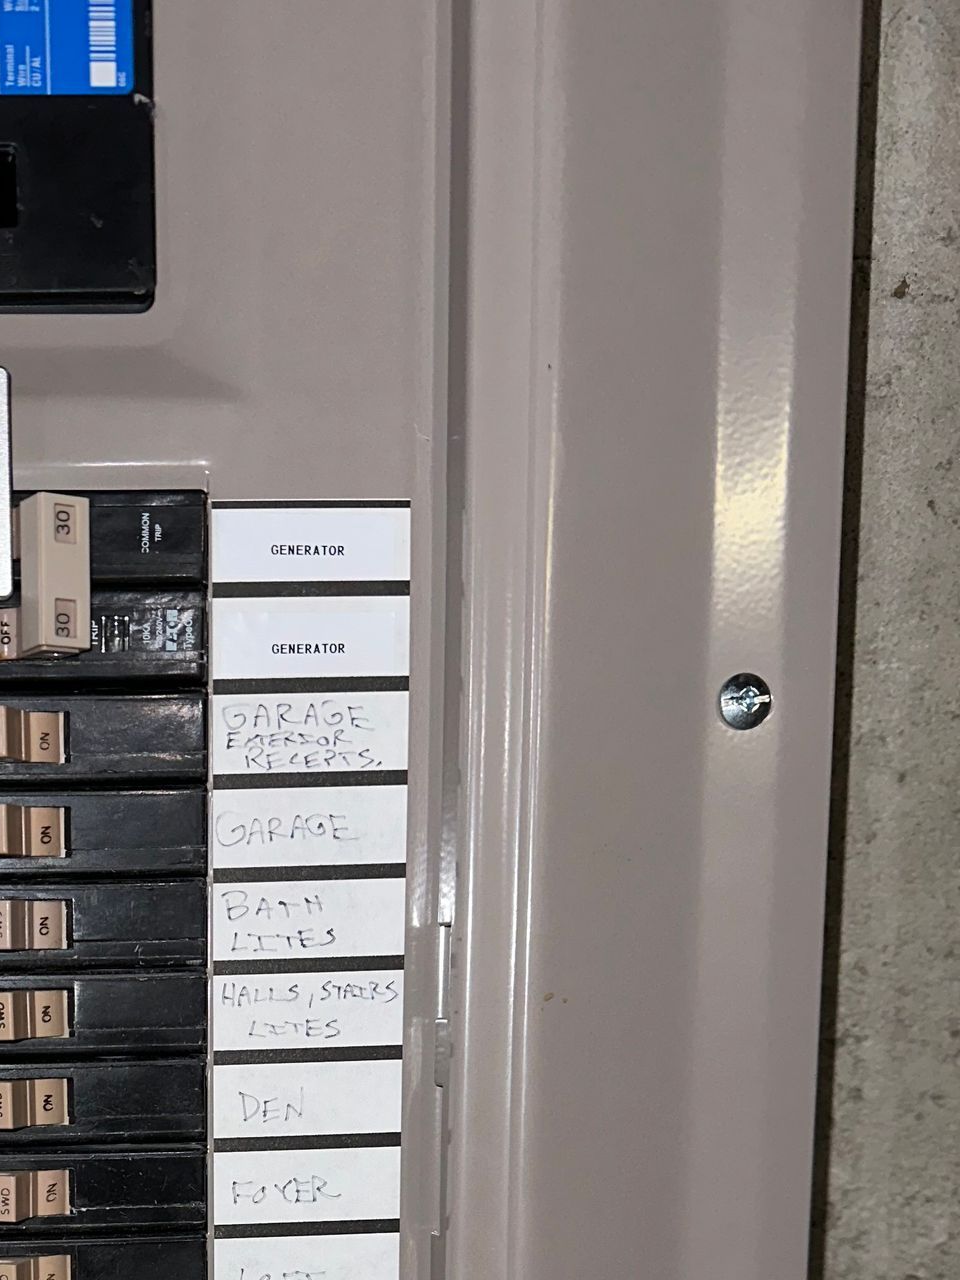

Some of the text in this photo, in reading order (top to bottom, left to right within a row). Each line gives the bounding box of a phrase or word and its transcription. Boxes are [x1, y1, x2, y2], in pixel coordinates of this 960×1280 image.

[55, 509, 71, 536] 30
[271, 544, 345, 556] GENERATOR
[0, 620, 12, 646] OFF
[56, 612, 71, 638] 30
[271, 643, 346, 655] GENERATOR
[222, 700, 375, 731] GARAGE
[215, 810, 361, 848] GARAGE
[221, 889, 324, 921] BATH
[231, 927, 337, 952] LITES
[41, 1004, 52, 1023] ON
[248, 1018, 342, 1039] LITES
[238, 1086, 304, 1123] DEN
[231, 1174, 342, 1205] FOYER
